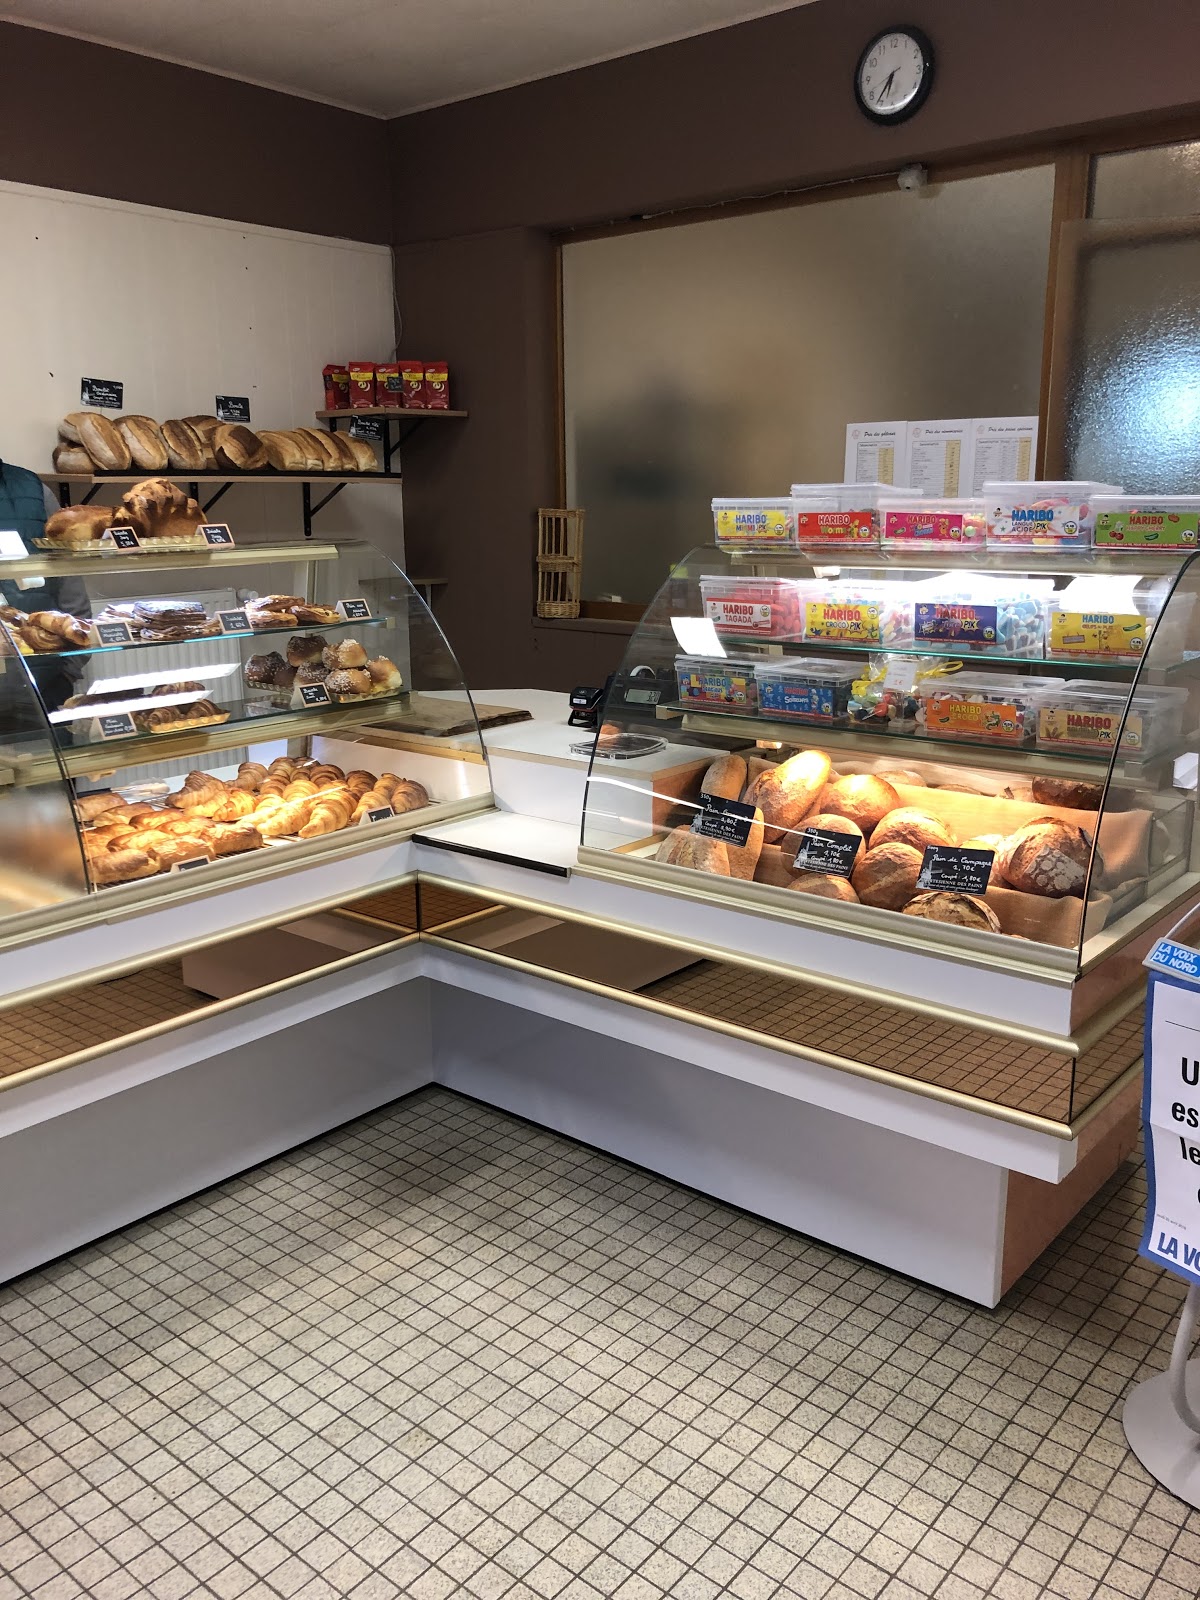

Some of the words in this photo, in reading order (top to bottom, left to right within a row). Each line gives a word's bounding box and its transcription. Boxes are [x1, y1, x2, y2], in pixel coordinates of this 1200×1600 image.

[890, 38, 899, 49] 12
[878, 45, 886, 56] 11
[869, 57, 878, 68] 10
[735, 514, 767, 524] HARIBO
[818, 514, 850, 525] HARIBO
[906, 515, 937, 525] HARIBO
[1011, 509, 1054, 522] HARIBO
[1129, 515, 1164, 525] HARIBO
[723, 603, 754, 615] HARIBO
[823, 608, 861, 621] HARIBO
[935, 605, 976, 620] HARIBO
[724, 615, 752, 624] TAGADA
[963, 620, 975, 629] PIK
[1082, 614, 1115, 624] HARIBO
[825, 621, 848, 629] CROCO
[849, 620, 861, 630] PIK
[699, 677, 727, 688] HARIBO
[949, 704, 982, 714] HARIBO
[951, 713, 979, 721] CROCO
[1066, 714, 1112, 730] HARIBO
[1100, 731, 1111, 739] PIK
[704, 804, 720, 815] Pain
[810, 838, 824, 848] Pain
[826, 841, 853, 853] Complet
[932, 853, 947, 862] Pain
[968, 881, 983, 889] PAINS
[1158, 943, 1172, 954] LA
[1152, 951, 1169, 963] DU
[1168, 957, 1198, 974] NORD
[1157, 1231, 1178, 1260] LA
